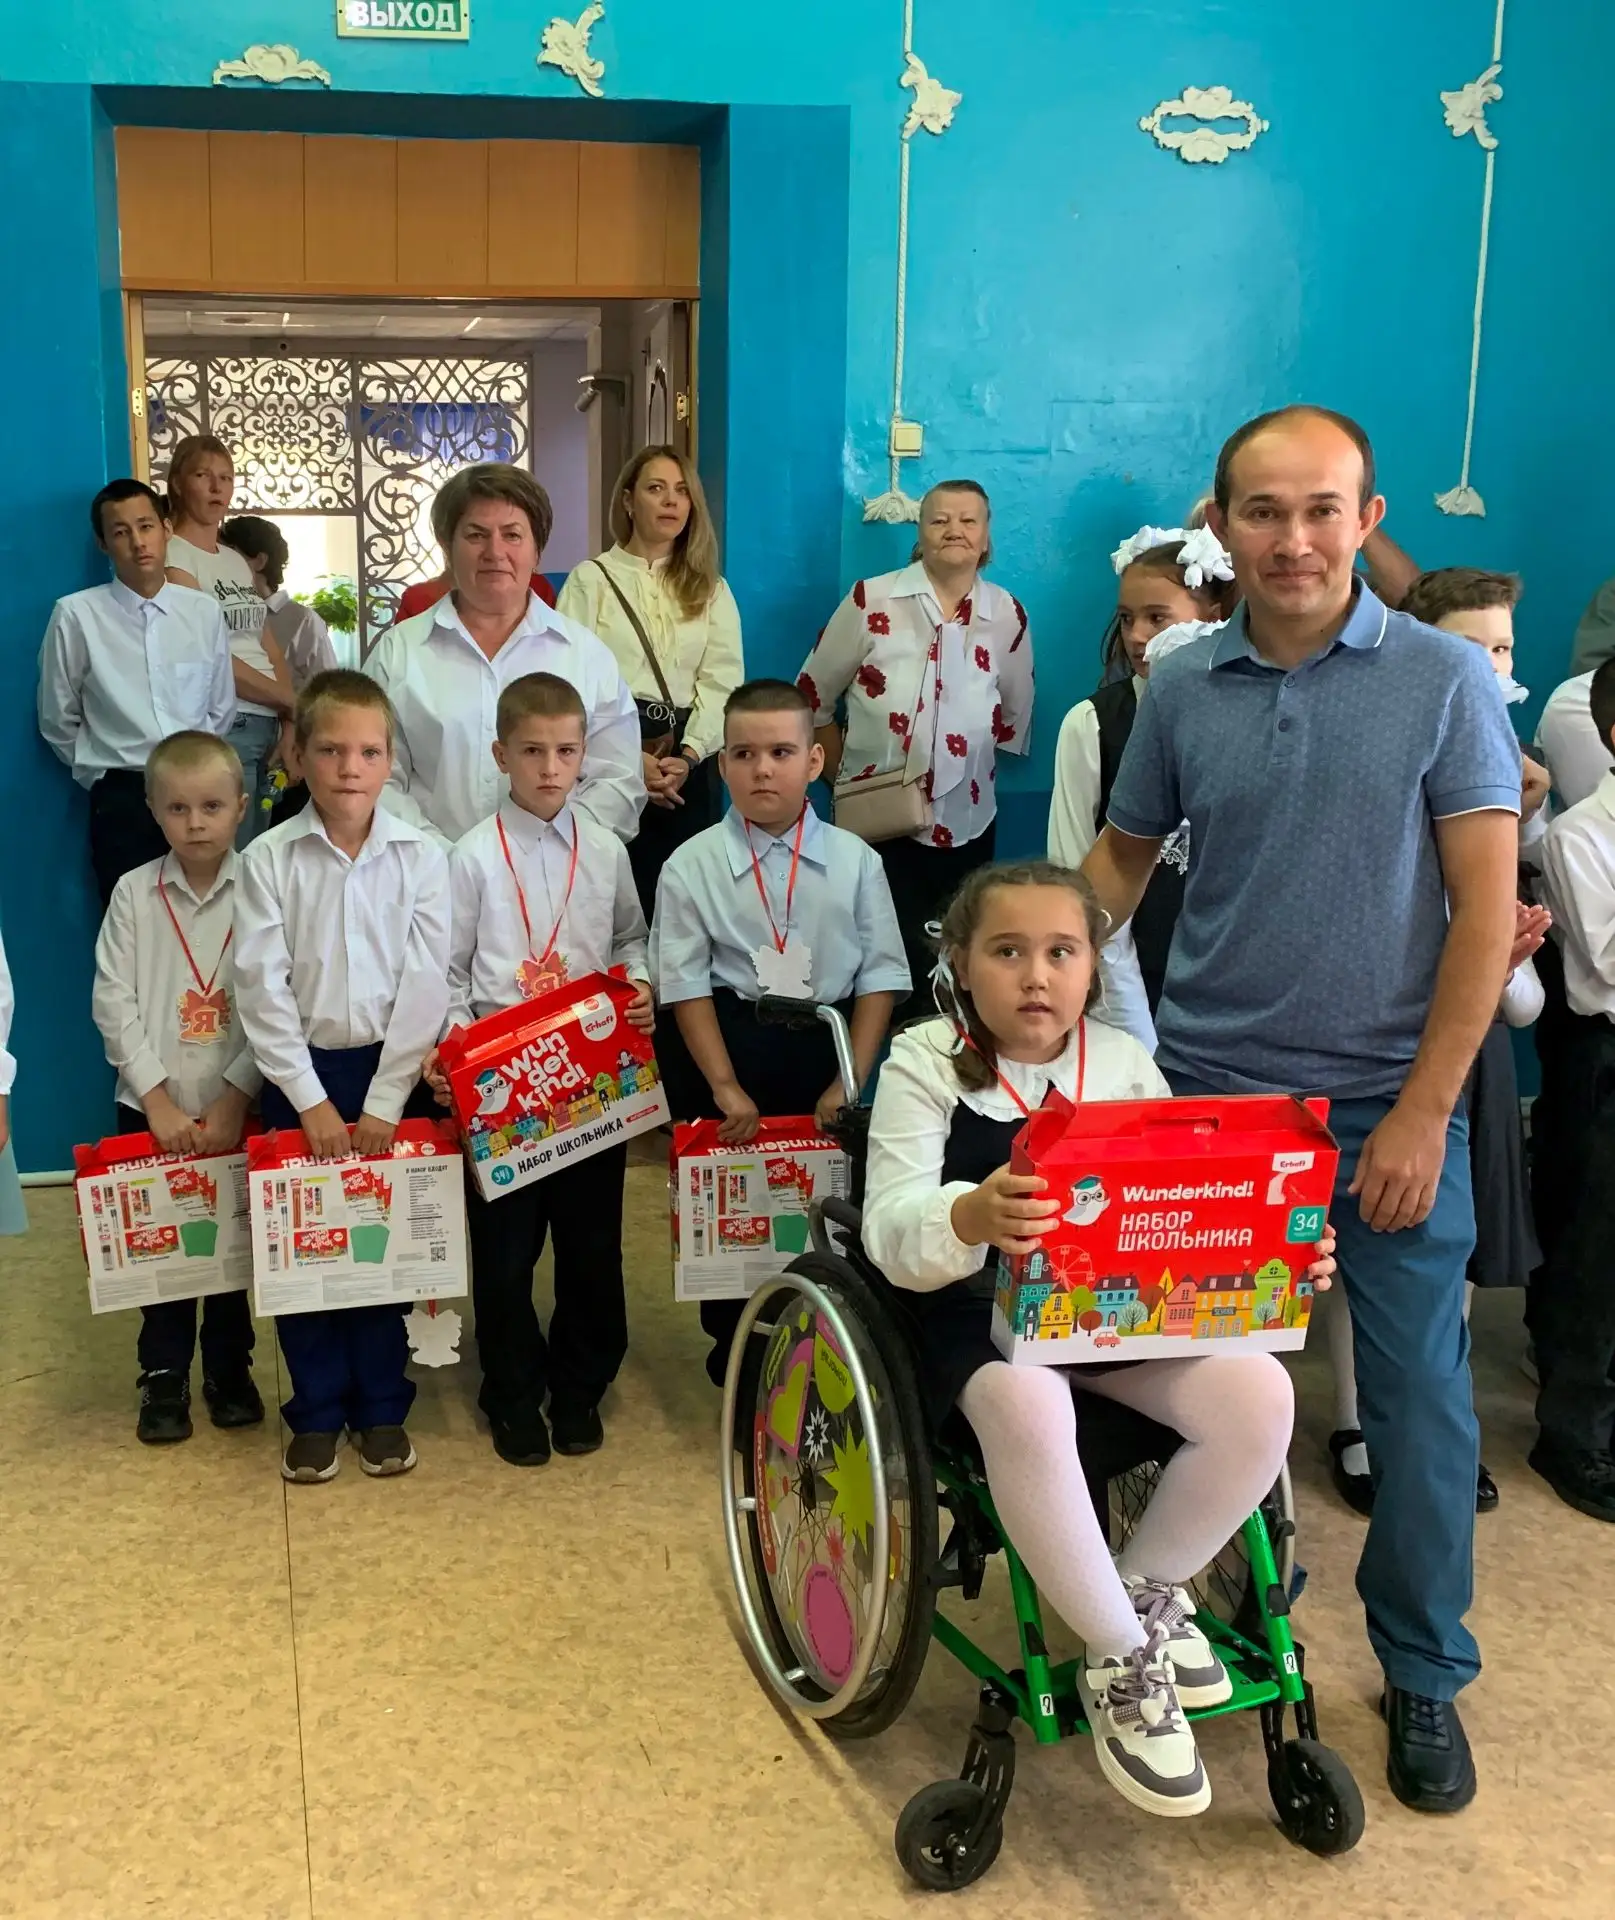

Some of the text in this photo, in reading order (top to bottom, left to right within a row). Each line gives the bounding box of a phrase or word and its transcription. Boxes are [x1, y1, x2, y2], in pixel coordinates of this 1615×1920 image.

[351, 1, 457, 31] ВЫХОД
[193, 1010, 217, 1033] Я
[527, 1044, 570, 1087] der
[517, 1117, 624, 1174] НАБОР ШКОЛЬНИКА
[1122, 1181, 1255, 1203] Wunderkind!
[1120, 1210, 1194, 1232] НАБОР
[1293, 1212, 1319, 1232] 34
[1117, 1228, 1254, 1252] ШКОЛЬНИКА
